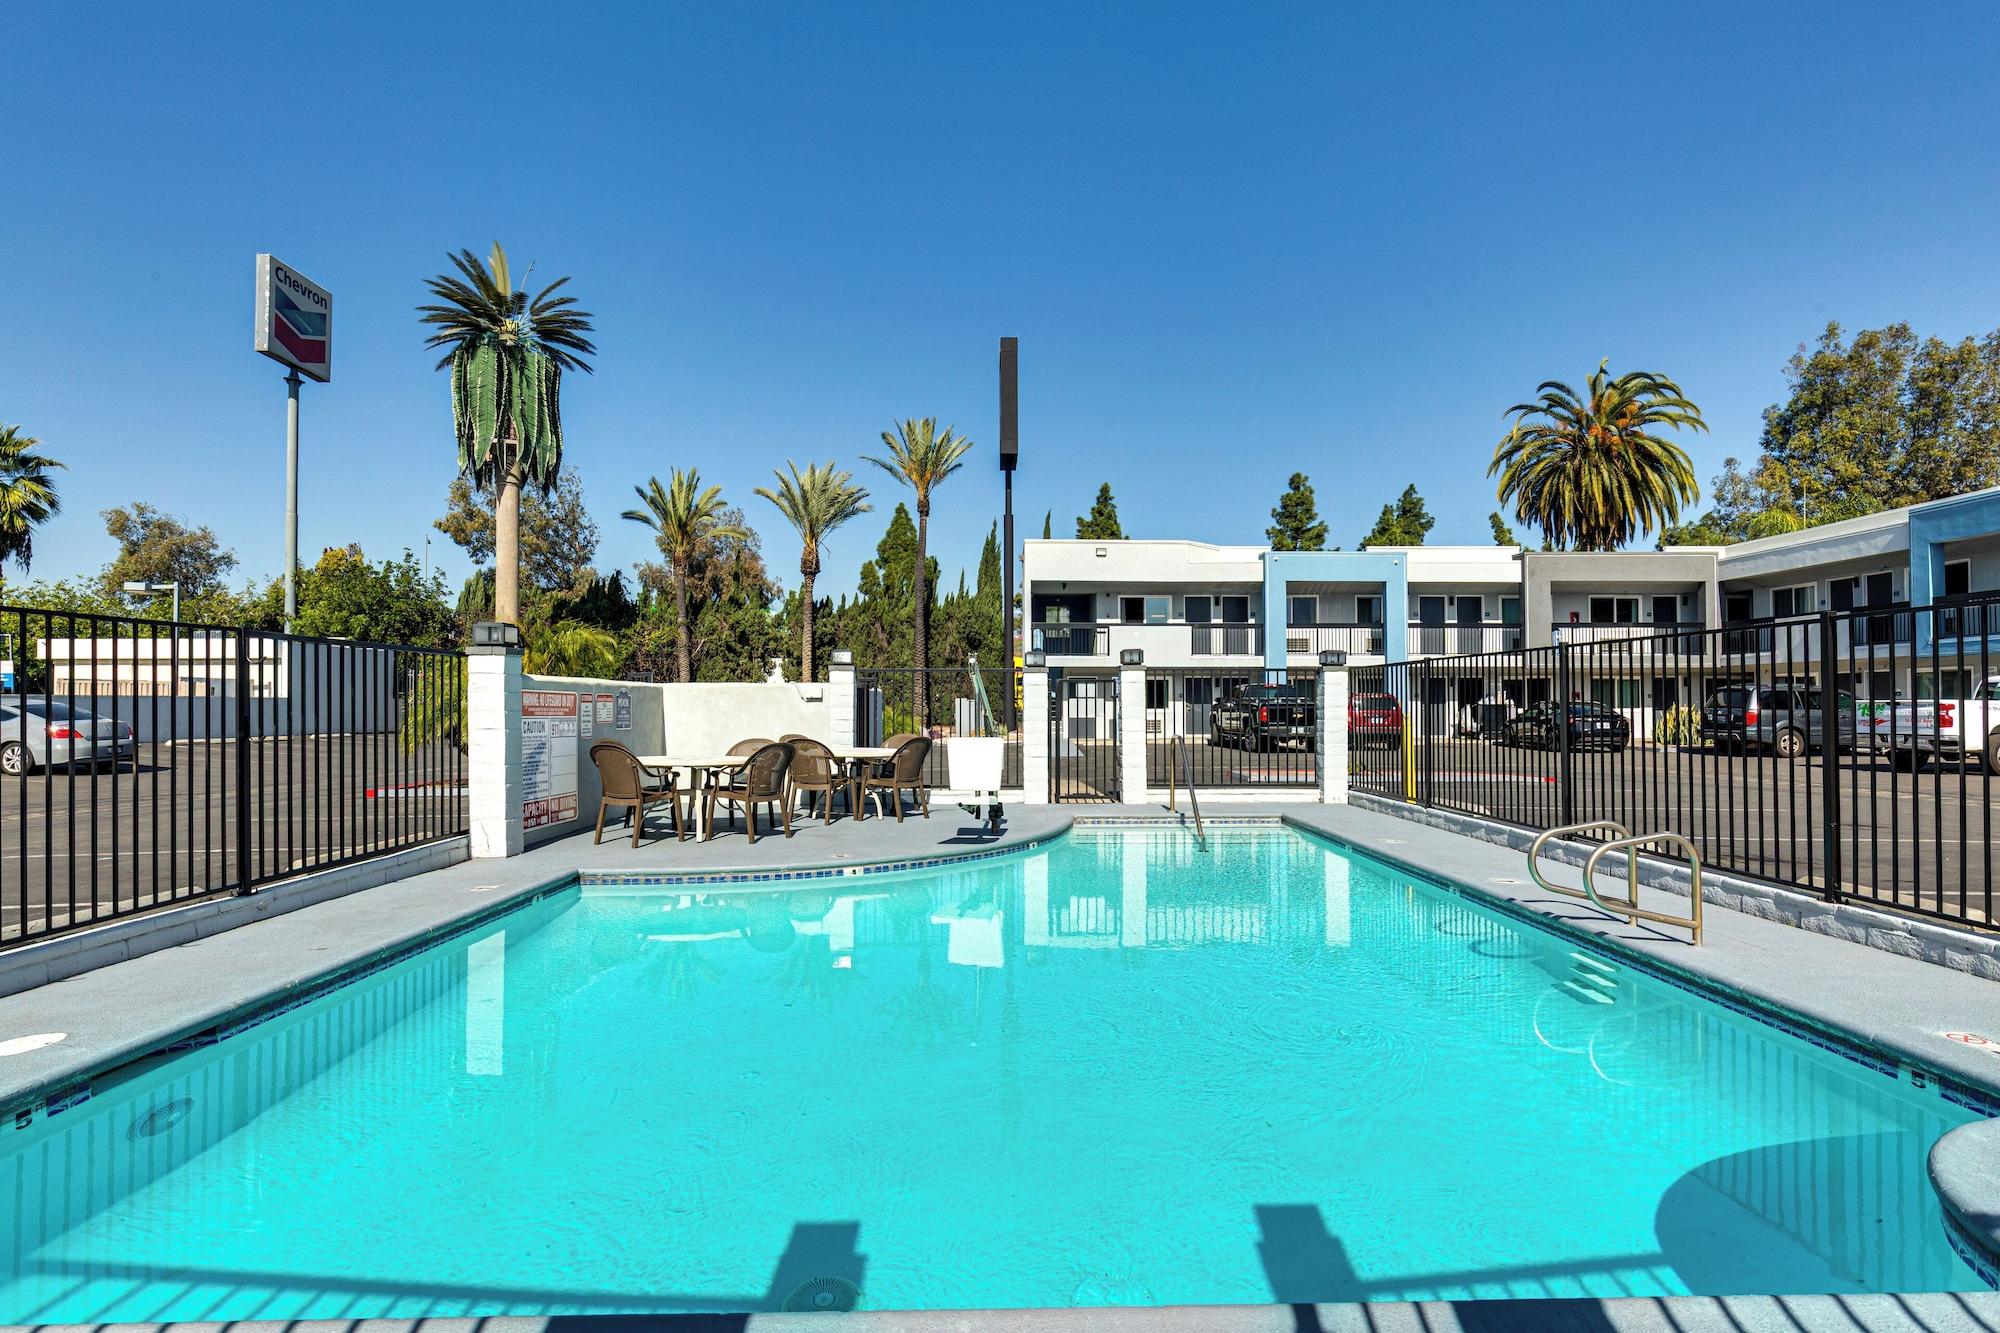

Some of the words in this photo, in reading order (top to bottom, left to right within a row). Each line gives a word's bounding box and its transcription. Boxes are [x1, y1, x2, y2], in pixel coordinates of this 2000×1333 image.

[275, 266, 327, 310] Chevron
[617, 698, 629, 708] POOL
[522, 720, 546, 734] CAUTION
[551, 723, 559, 735] 911
[523, 800, 548, 818] APACITY
[551, 798, 559, 812] NO
[559, 796, 577, 811] DIVING
